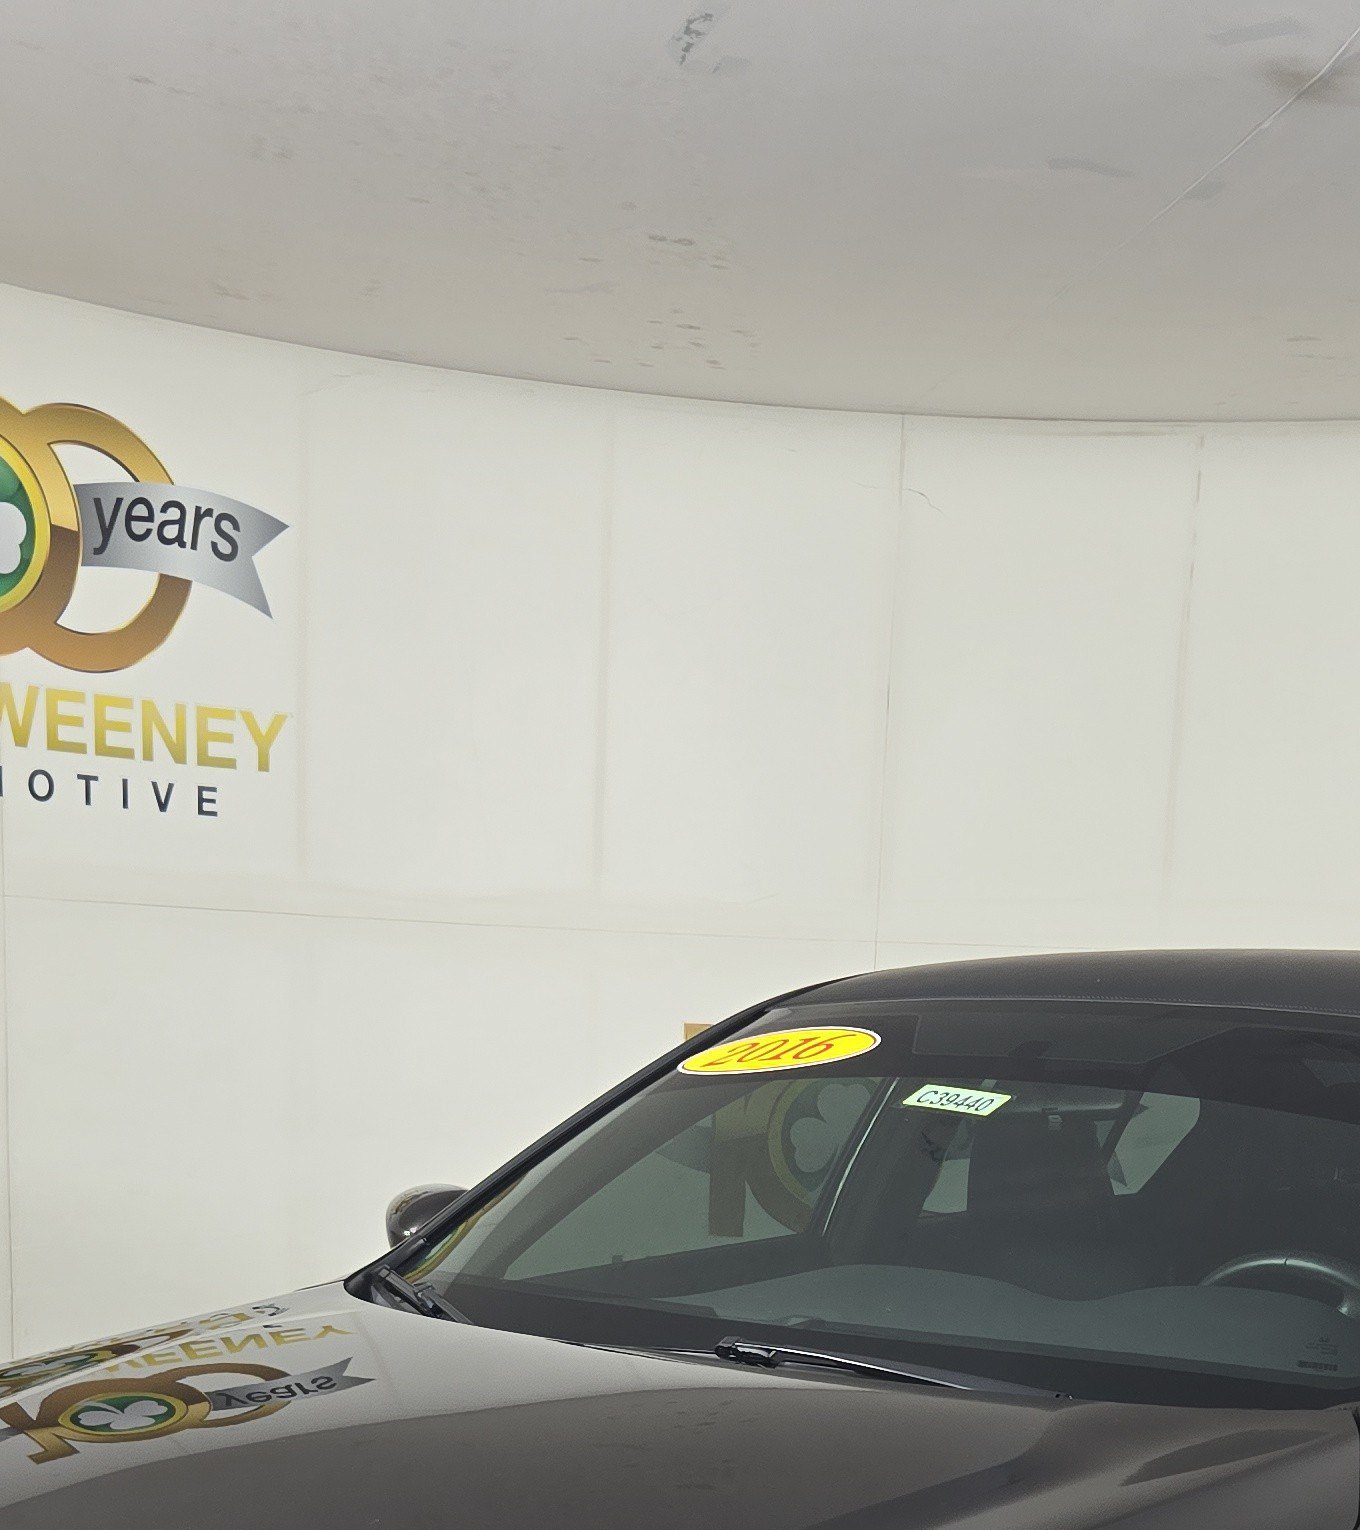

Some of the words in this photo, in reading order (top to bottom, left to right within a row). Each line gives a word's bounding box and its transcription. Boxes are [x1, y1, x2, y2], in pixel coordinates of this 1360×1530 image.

[92, 495, 242, 562] years
[701, 1033, 857, 1067] 2016
[916, 1089, 994, 1112] C39440
